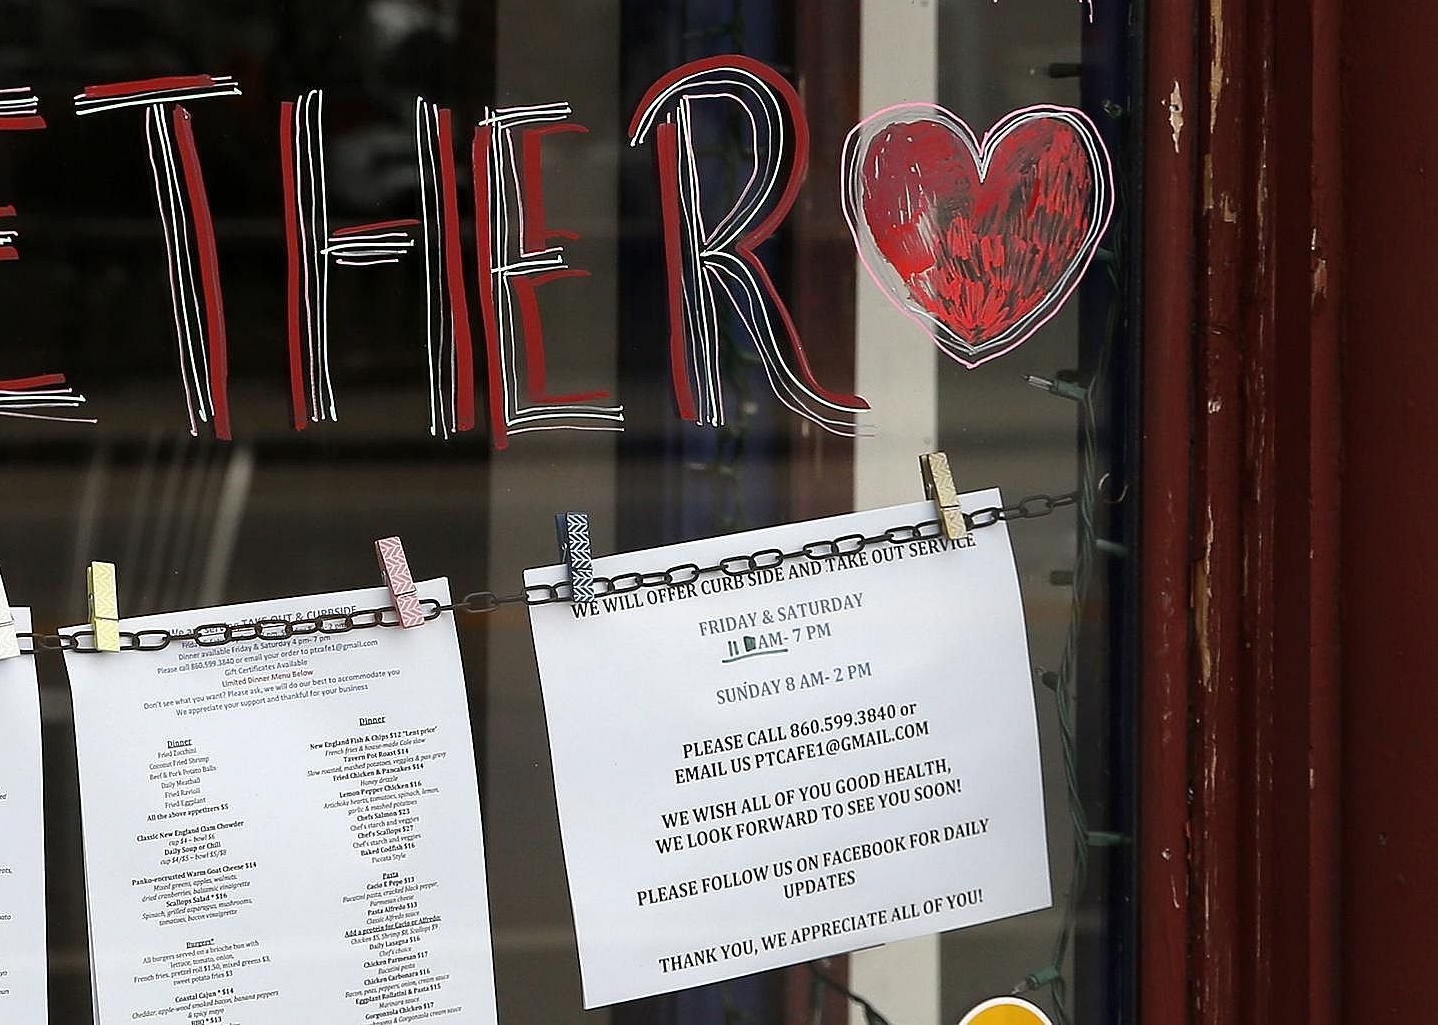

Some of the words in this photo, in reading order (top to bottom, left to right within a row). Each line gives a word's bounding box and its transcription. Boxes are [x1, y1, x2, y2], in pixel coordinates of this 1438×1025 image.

[571, 602, 599, 618] WE
[603, 593, 643, 614] WILL
[647, 584, 697, 605] OFFER
[701, 575, 744, 595] CURB
[749, 567, 784, 586] SIDE
[789, 561, 821, 580] AND
[825, 553, 868, 573] TAKE
[872, 546, 905, 564] OUT
[909, 533, 976, 557] SERVICE
[698, 612, 756, 636] FRIDAY
[762, 610, 774, 624] &
[777, 592, 862, 621] SATURDAY
[759, 631, 788, 649] AM-
[792, 628, 801, 643] 7
[806, 623, 832, 640] PM
[221, 677, 246, 689] Limited
[247, 674, 269, 683] Dinner
[271, 669, 291, 680] Menu
[292, 667, 314, 680] Below
[716, 679, 780, 704] SUNDAY
[785, 677, 795, 691] 8
[800, 671, 829, 689] AM-
[833, 667, 843, 682] 2
[847, 662, 872, 679] PM
[674, 761, 727, 784] EMAIL
[730, 756, 751, 773] US
[754, 720, 928, 768] PTCAFE1@GMAIL.COM
[682, 734, 743, 759] PLEASE
[747, 726, 786, 746] CALL
[790, 704, 895, 738] 860.599.3840
[900, 703, 916, 716] or
[655, 835, 683, 853] WE
[686, 826, 733, 848] LOOK
[735, 809, 817, 838] FORWARD
[821, 803, 843, 820] TO
[847, 796, 875, 815] SEE
[877, 789, 910, 808] YOU
[914, 779, 961, 801] SOON!
[661, 810, 689, 828] WE
[692, 801, 737, 822] WISH
[741, 795, 771, 814] ALL
[774, 789, 794, 806] OF
[798, 782, 831, 801] YOU
[835, 772, 880, 794] GOOD
[884, 759, 951, 784] HEALTH,
[637, 880, 698, 906] PLEASE
[701, 865, 768, 893] FOLLOW
[773, 860, 792, 877] US
[796, 855, 818, 872] ON
[822, 836, 906, 867] FACEBOOK
[909, 829, 940, 848] FOR
[943, 818, 989, 841] DAILY
[783, 870, 855, 898] UPDATES
[658, 947, 718, 973] THANK
[720, 939, 757, 959] YOU,
[761, 932, 787, 950] WE
[790, 910, 887, 944] APPRECIATE
[891, 903, 920, 922] ALL
[923, 897, 943, 914] OF
[946, 888, 983, 909] YOU!
